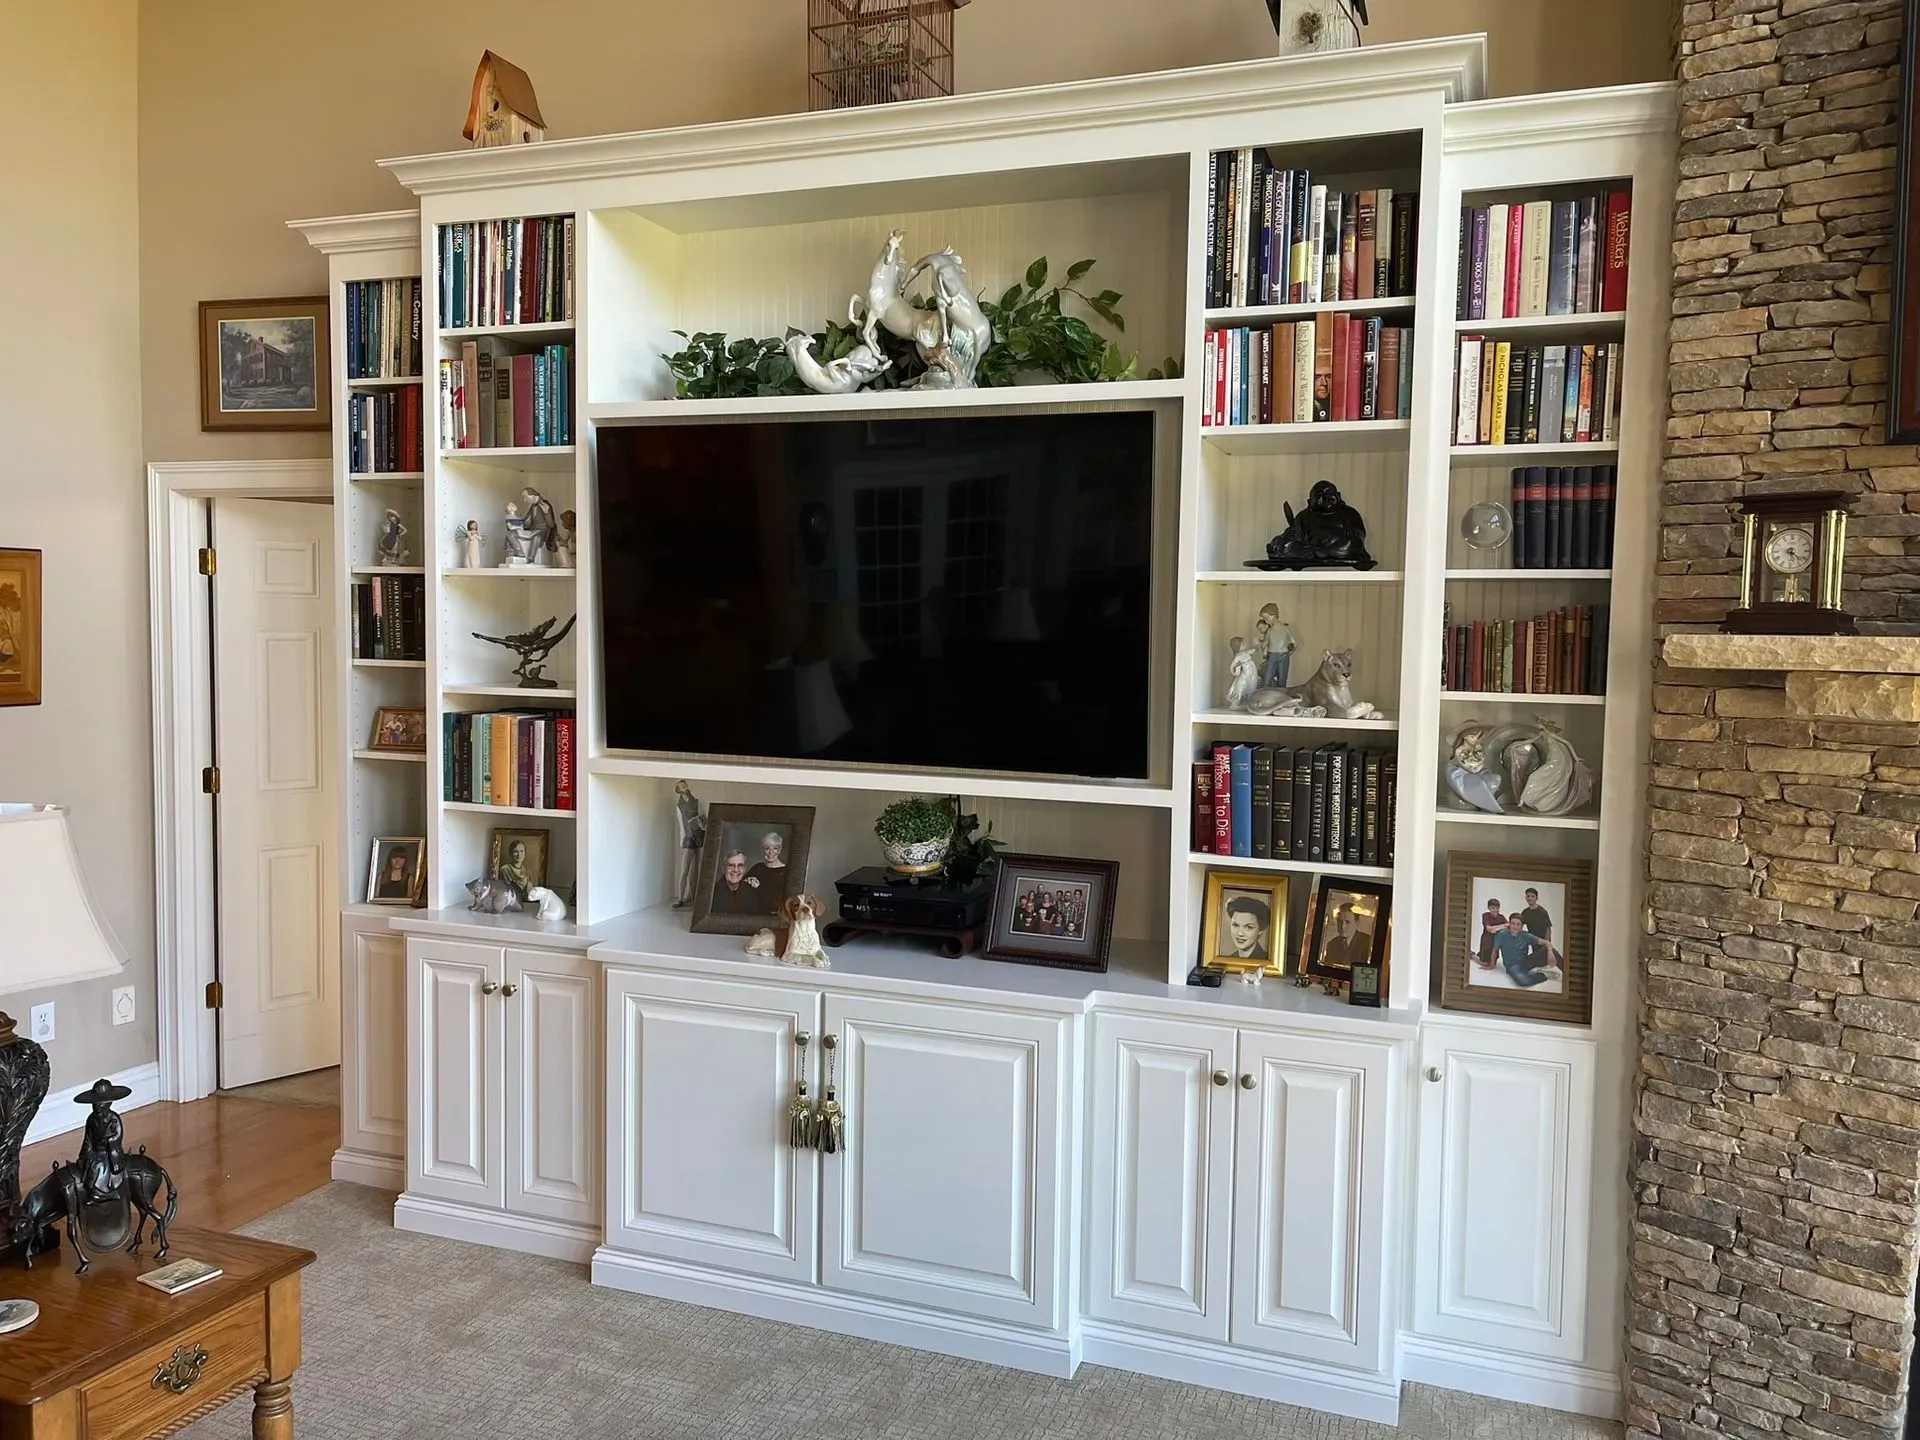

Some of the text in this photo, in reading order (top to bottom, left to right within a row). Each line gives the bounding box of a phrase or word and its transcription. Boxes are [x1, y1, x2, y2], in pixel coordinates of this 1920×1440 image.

[1209, 152, 1217, 178] ATTLES
[1208, 187, 1216, 206] THE
[1252, 162, 1263, 213] BALTIMORE
[1265, 174, 1273, 196] SONG
[1264, 202, 1272, 228] DANCE
[1296, 174, 1306, 236] THE SMITHSONIAN
[1273, 209, 1283, 235] NATURE
[1206, 222, 1215, 256] CENTURY
[1225, 249, 1234, 261] THE
[1226, 230, 1234, 248] WITH
[1613, 210, 1629, 269] Webster's
[505, 249, 514, 270] Rights
[1215, 248, 1224, 272] ALASKA
[1224, 261, 1233, 281] WIND
[1475, 262, 1483, 278] DOGS
[1378, 259, 1386, 298] MERRIC
[411, 300, 421, 341] Century
[1299, 324, 1310, 340] The
[1299, 340, 1310, 373] Duchess
[538, 365, 546, 397] WORLD'S
[1468, 356, 1479, 421] RONALD REAGAN
[1495, 354, 1506, 420] NICHOLAS SPARKS
[1298, 382, 1309, 414] Windsor
[393, 580, 402, 650] AMERICAN SOLDIER
[561, 723, 570, 789] MERCK MANUAL
[1214, 753, 1224, 790] PATTERSON
[1221, 753, 1231, 775] JAMES
[1331, 755, 1342, 814] POP GOES THE WEASEL
[1366, 763, 1377, 806] THE LAST CASTLE
[1215, 792, 1231, 837] 1st to Die
[1312, 783, 1324, 839] ENCHANTMENT
[1350, 805, 1359, 838] MERRICK
[1330, 818, 1341, 850] PATTERSON
[1361, 968, 1375, 980] 52
